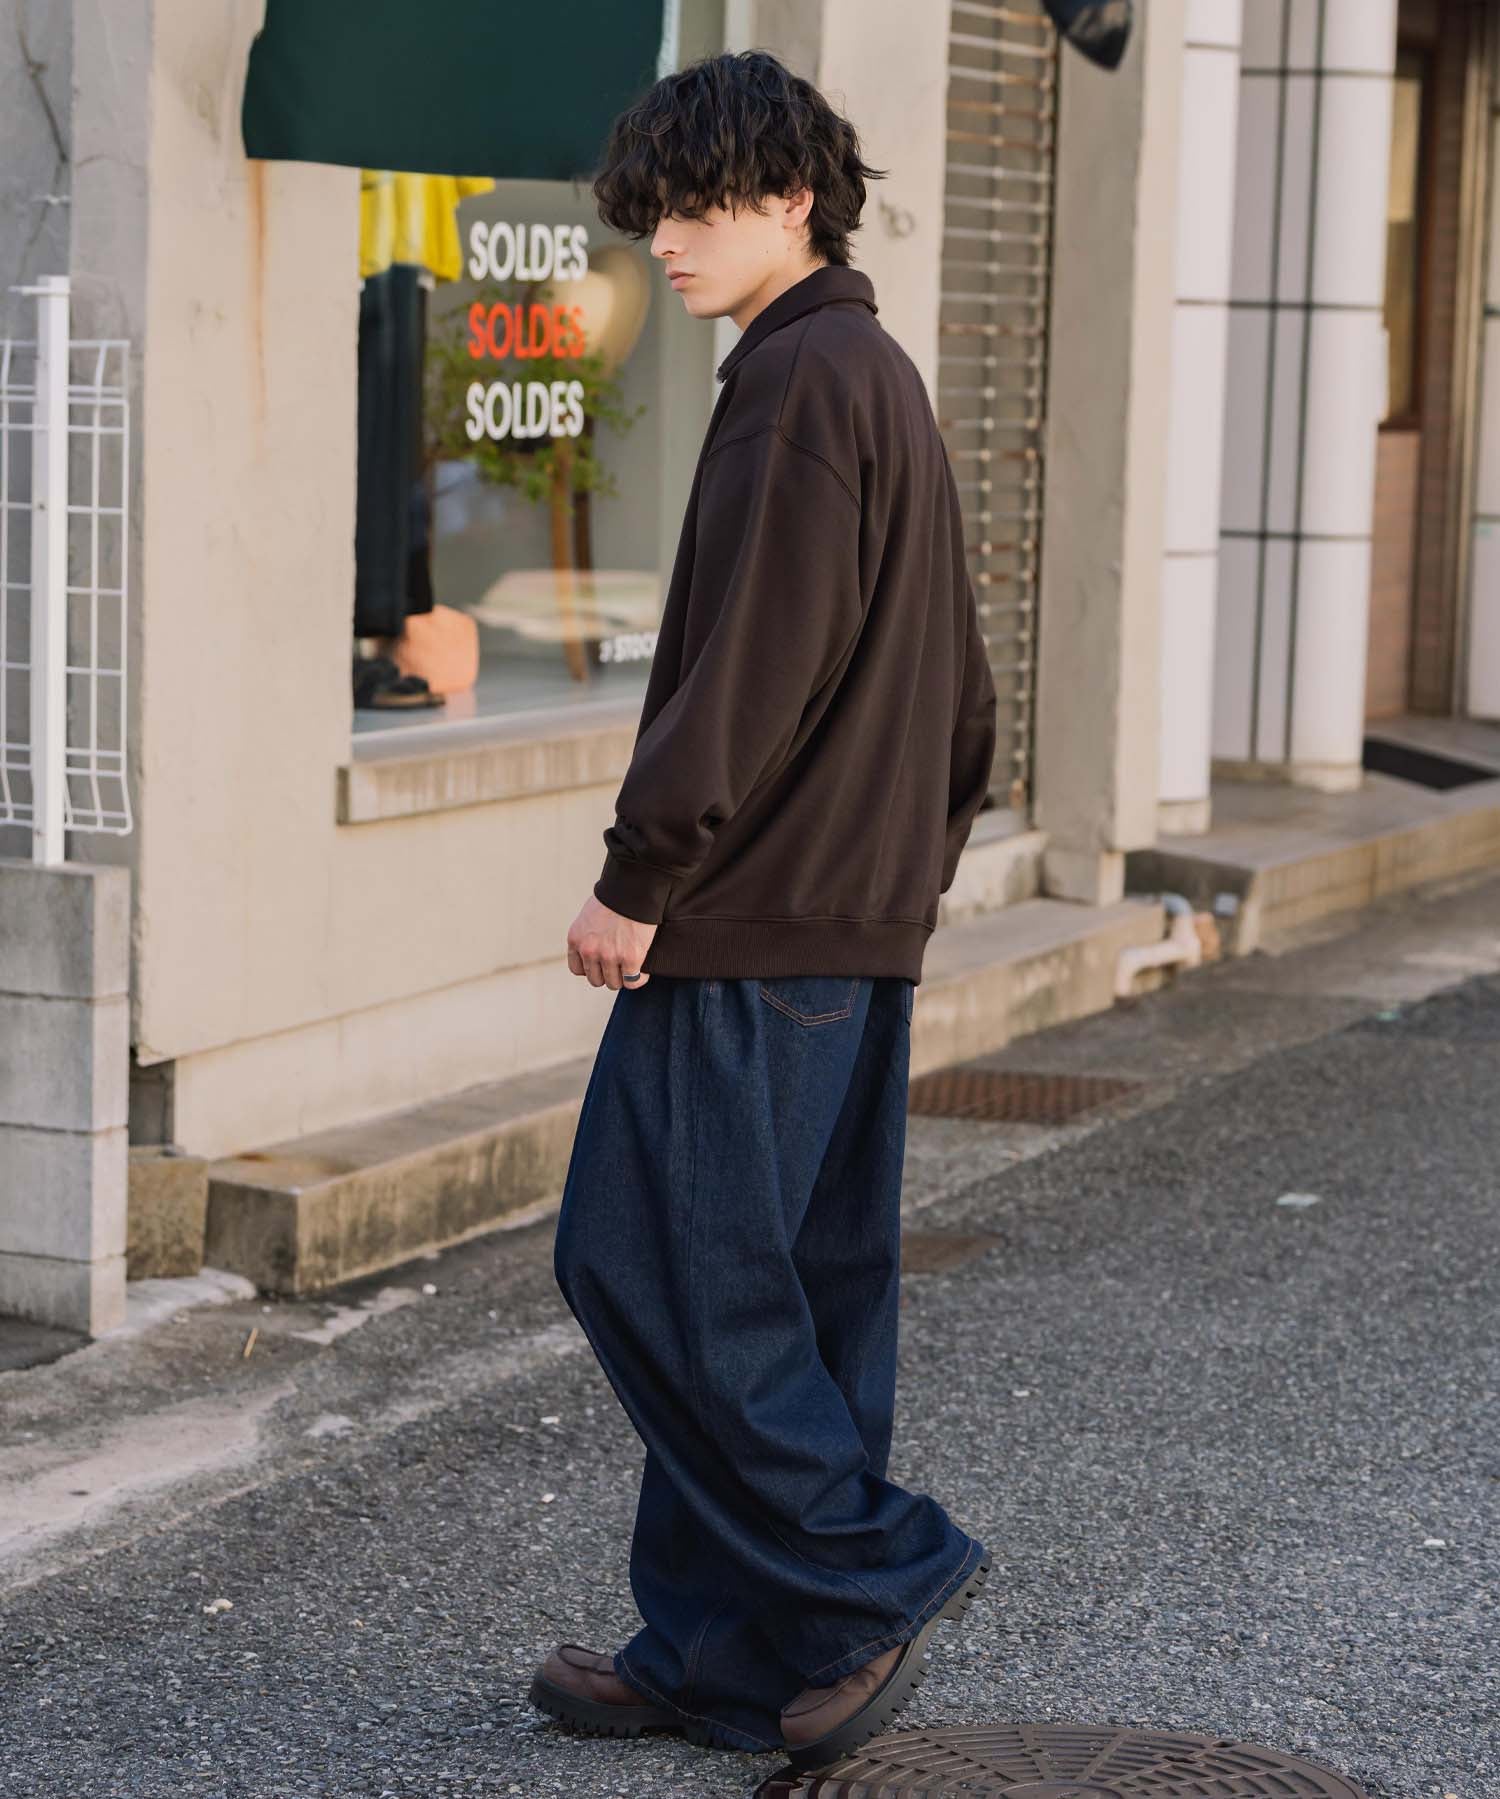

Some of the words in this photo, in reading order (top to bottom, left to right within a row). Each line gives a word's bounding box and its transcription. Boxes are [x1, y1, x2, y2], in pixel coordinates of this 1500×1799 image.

[469, 221, 589, 281] SOLDES
[468, 302, 586, 359] SOLDES
[465, 380, 585, 441] SOLDES
